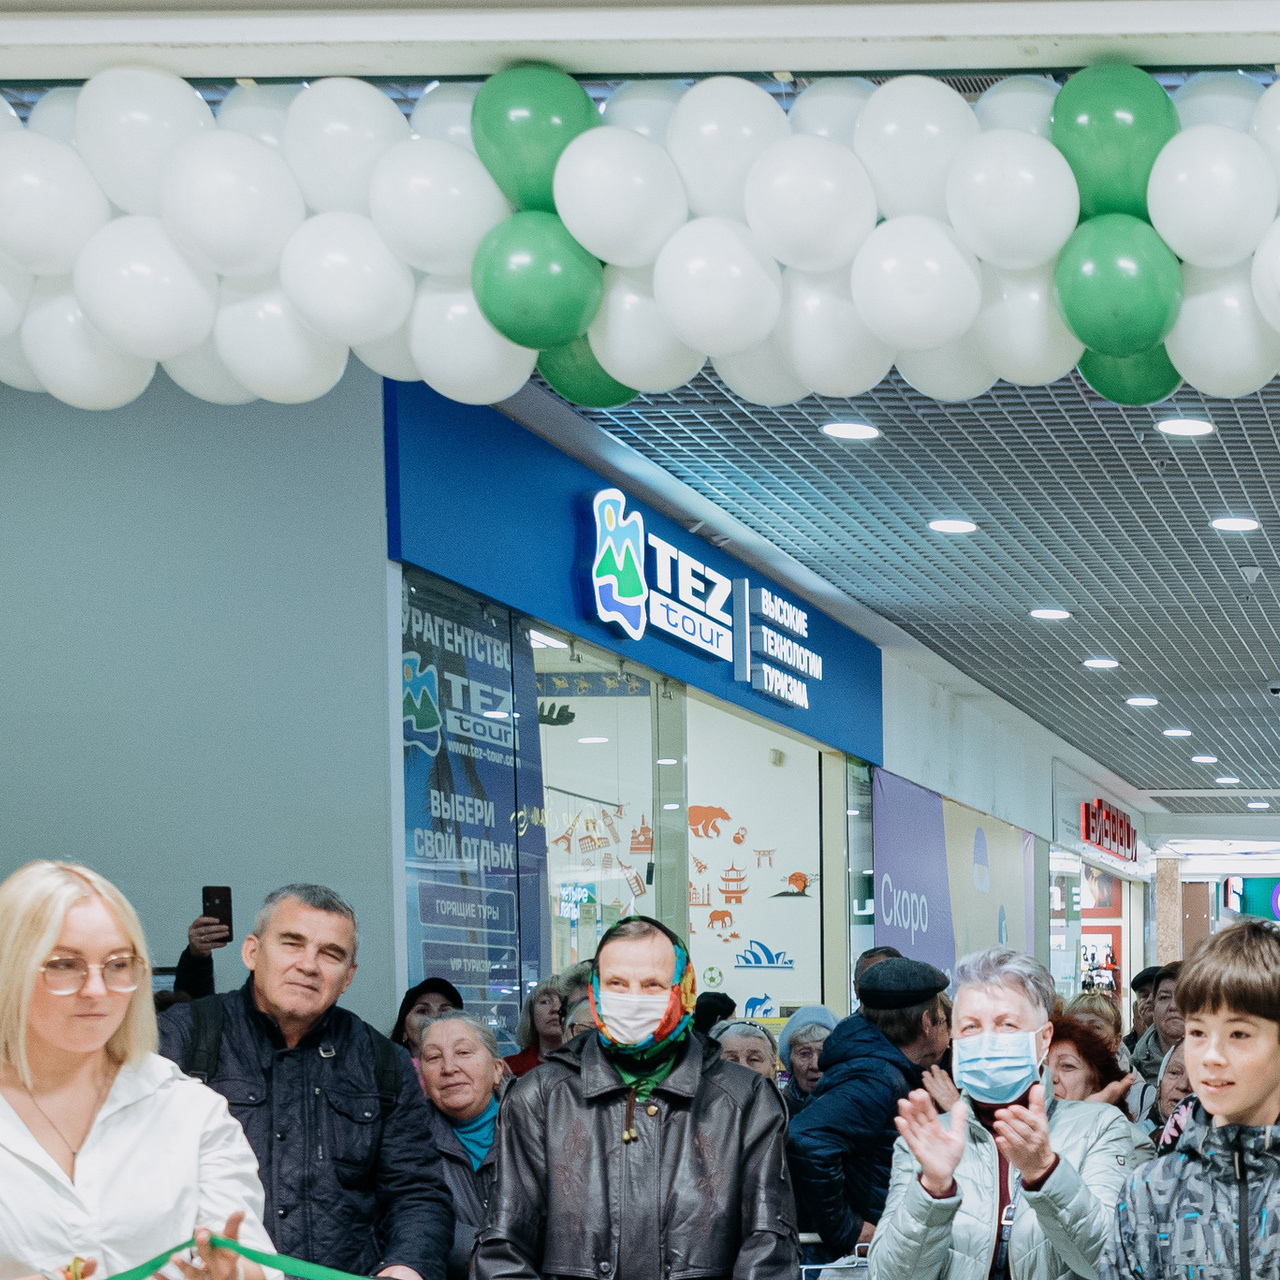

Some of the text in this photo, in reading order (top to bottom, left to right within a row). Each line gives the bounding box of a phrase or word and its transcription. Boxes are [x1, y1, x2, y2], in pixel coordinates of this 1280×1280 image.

[648, 533, 732, 627] TEZ
[660, 603, 724, 649] tour
[761, 587, 809, 638] ВЫСОКИЕ
[762, 625, 823, 681] ТЕХНОЛОГИИ
[444, 671, 518, 722] TEZ
[762, 662, 809, 710] ТУРИЗМА
[454, 714, 513, 743] tour
[430, 788, 495, 829] ВЫБЕРИ
[413, 826, 515, 872] СВОЙ ОТДЫХ
[436, 899, 500, 921] ГОРЯЩИЕ ТУРЫ
[881, 873, 928, 945] Скоро
[450, 957, 492, 973] VIP ТУРИЗМ
